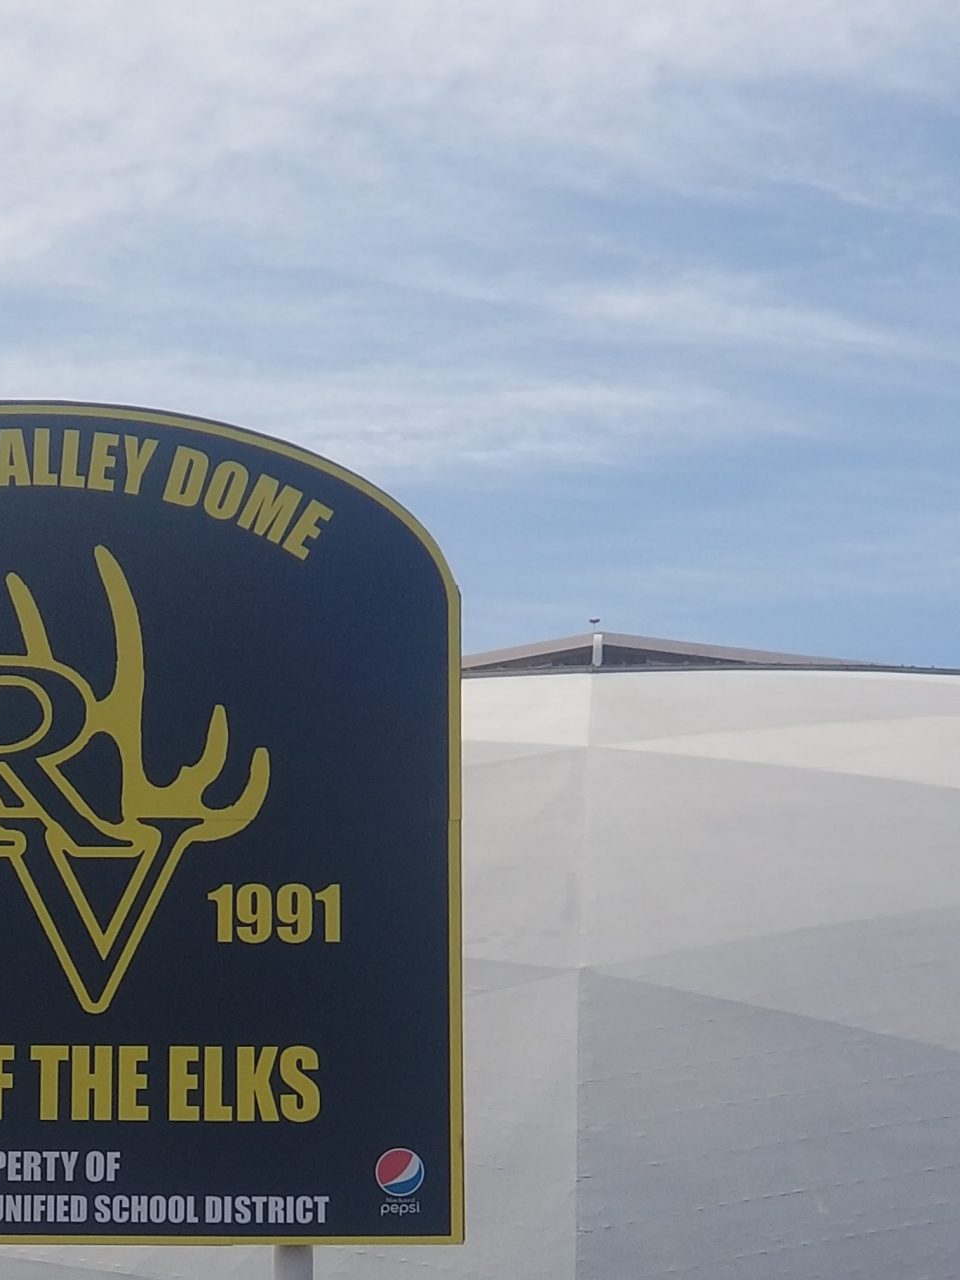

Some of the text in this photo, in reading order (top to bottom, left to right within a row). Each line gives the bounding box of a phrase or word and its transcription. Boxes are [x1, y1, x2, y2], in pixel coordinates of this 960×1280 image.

[162, 445, 334, 561] DOME
[207, 884, 342, 944] 1991
[30, 1044, 150, 1121] THE
[168, 1045, 321, 1122] ELKS
[85, 1150, 121, 1183] OF
[94, 1194, 199, 1224] SCHOOL
[204, 1195, 330, 1224] DISTRICT
[380, 1201, 420, 1216] pepsi
